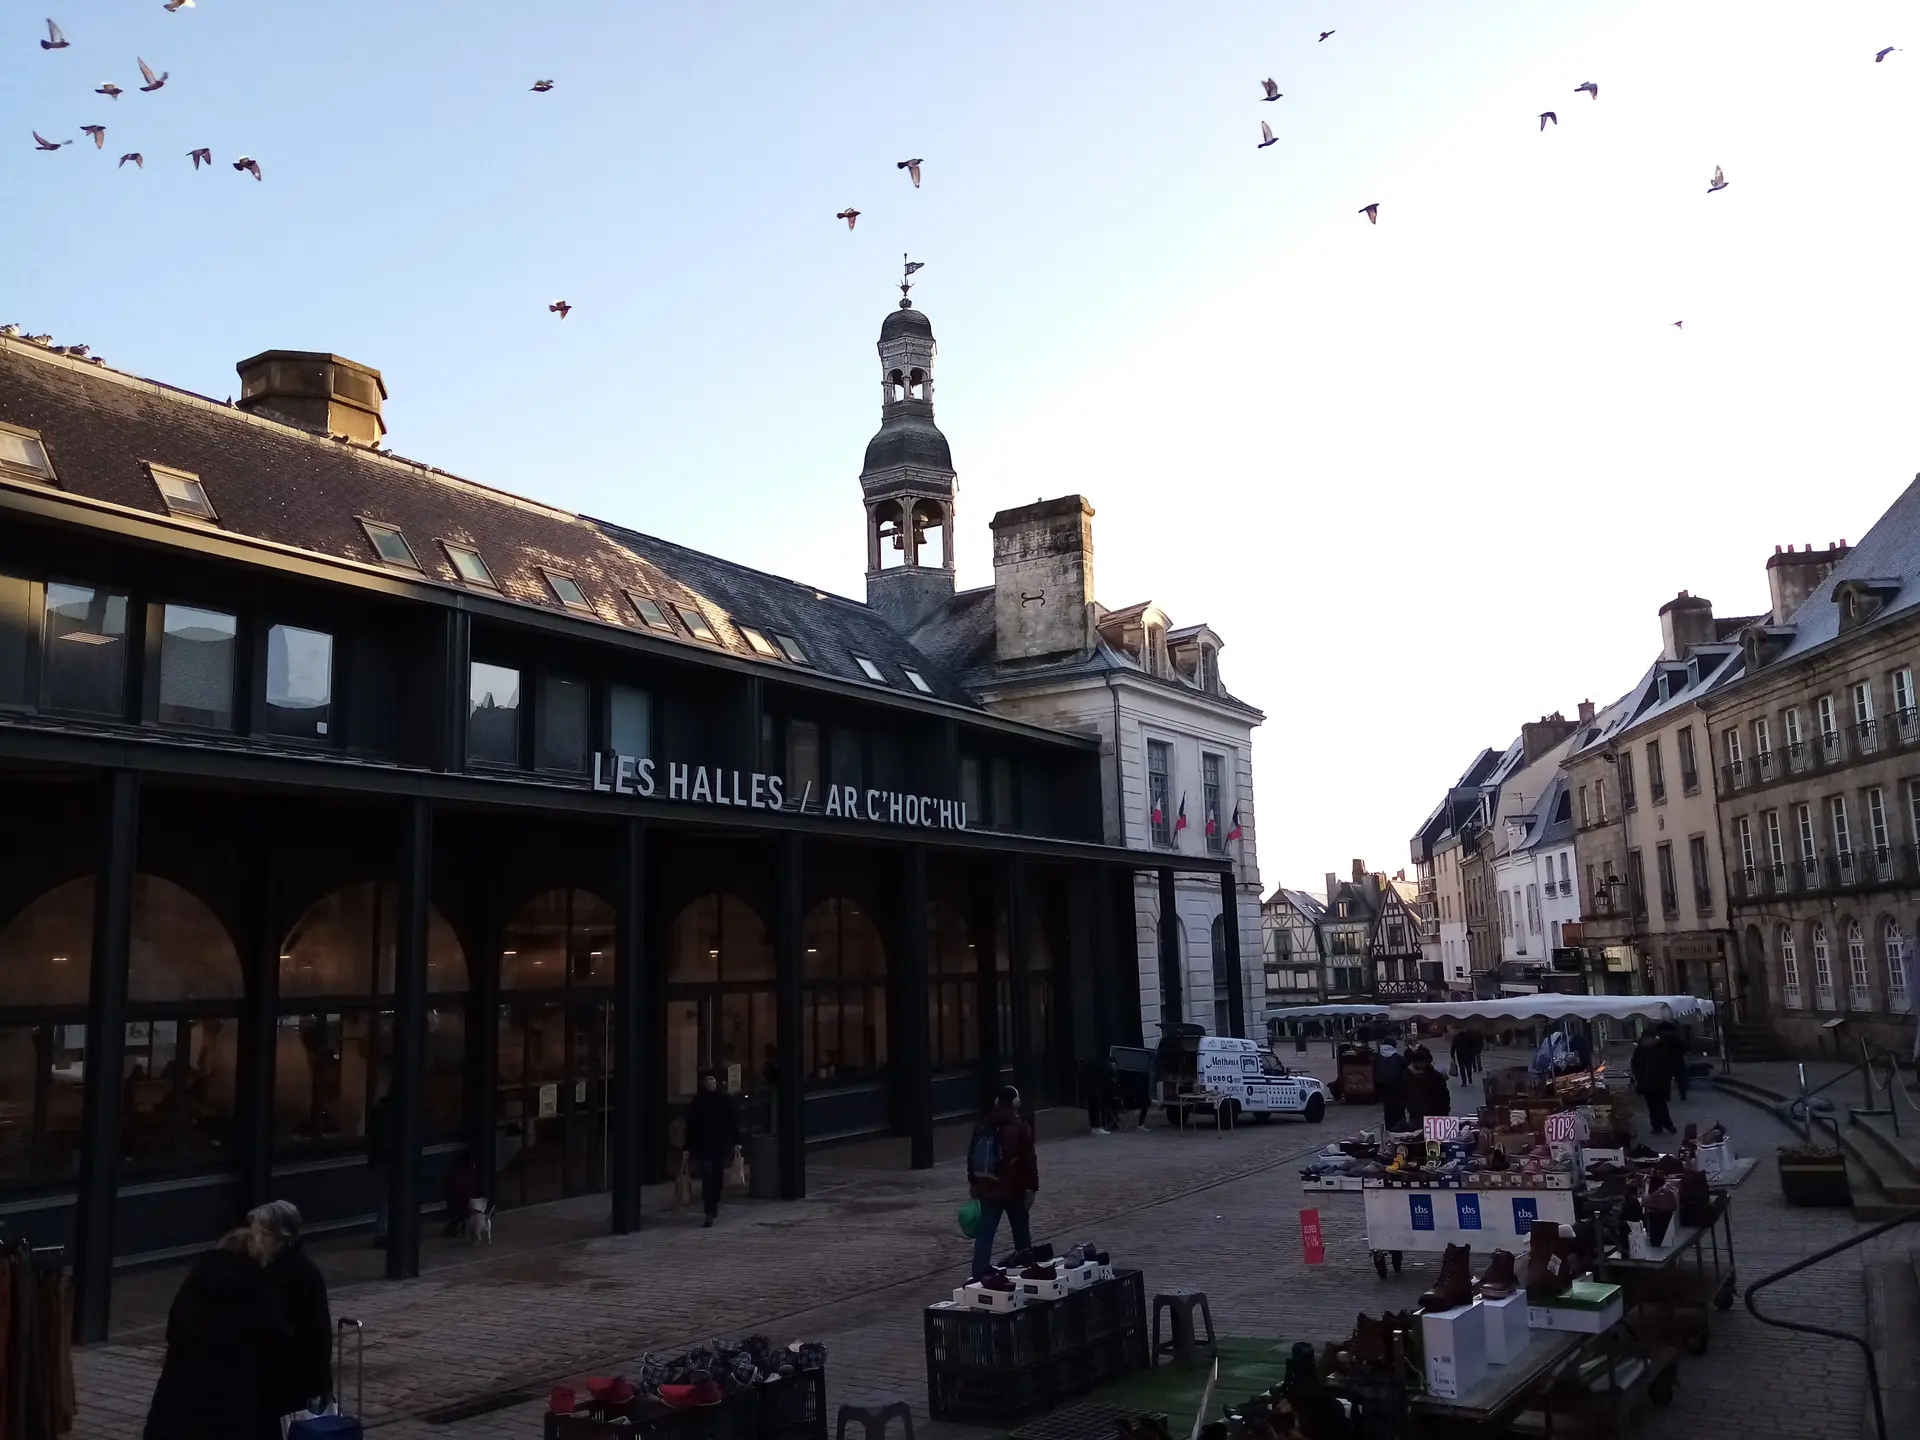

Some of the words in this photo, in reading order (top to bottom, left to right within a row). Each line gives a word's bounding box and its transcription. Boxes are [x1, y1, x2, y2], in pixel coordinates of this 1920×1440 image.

[592, 751, 655, 797] LES
[669, 761, 784, 811] HALLES
[825, 783, 858, 819] AR
[1425, 1117, 1458, 1141] -10%
[1548, 1116, 1576, 1141] -10%
[1414, 1204, 1429, 1214] tbs
[1461, 1204, 1476, 1214] tbs
[1518, 1208, 1533, 1218] tbs
